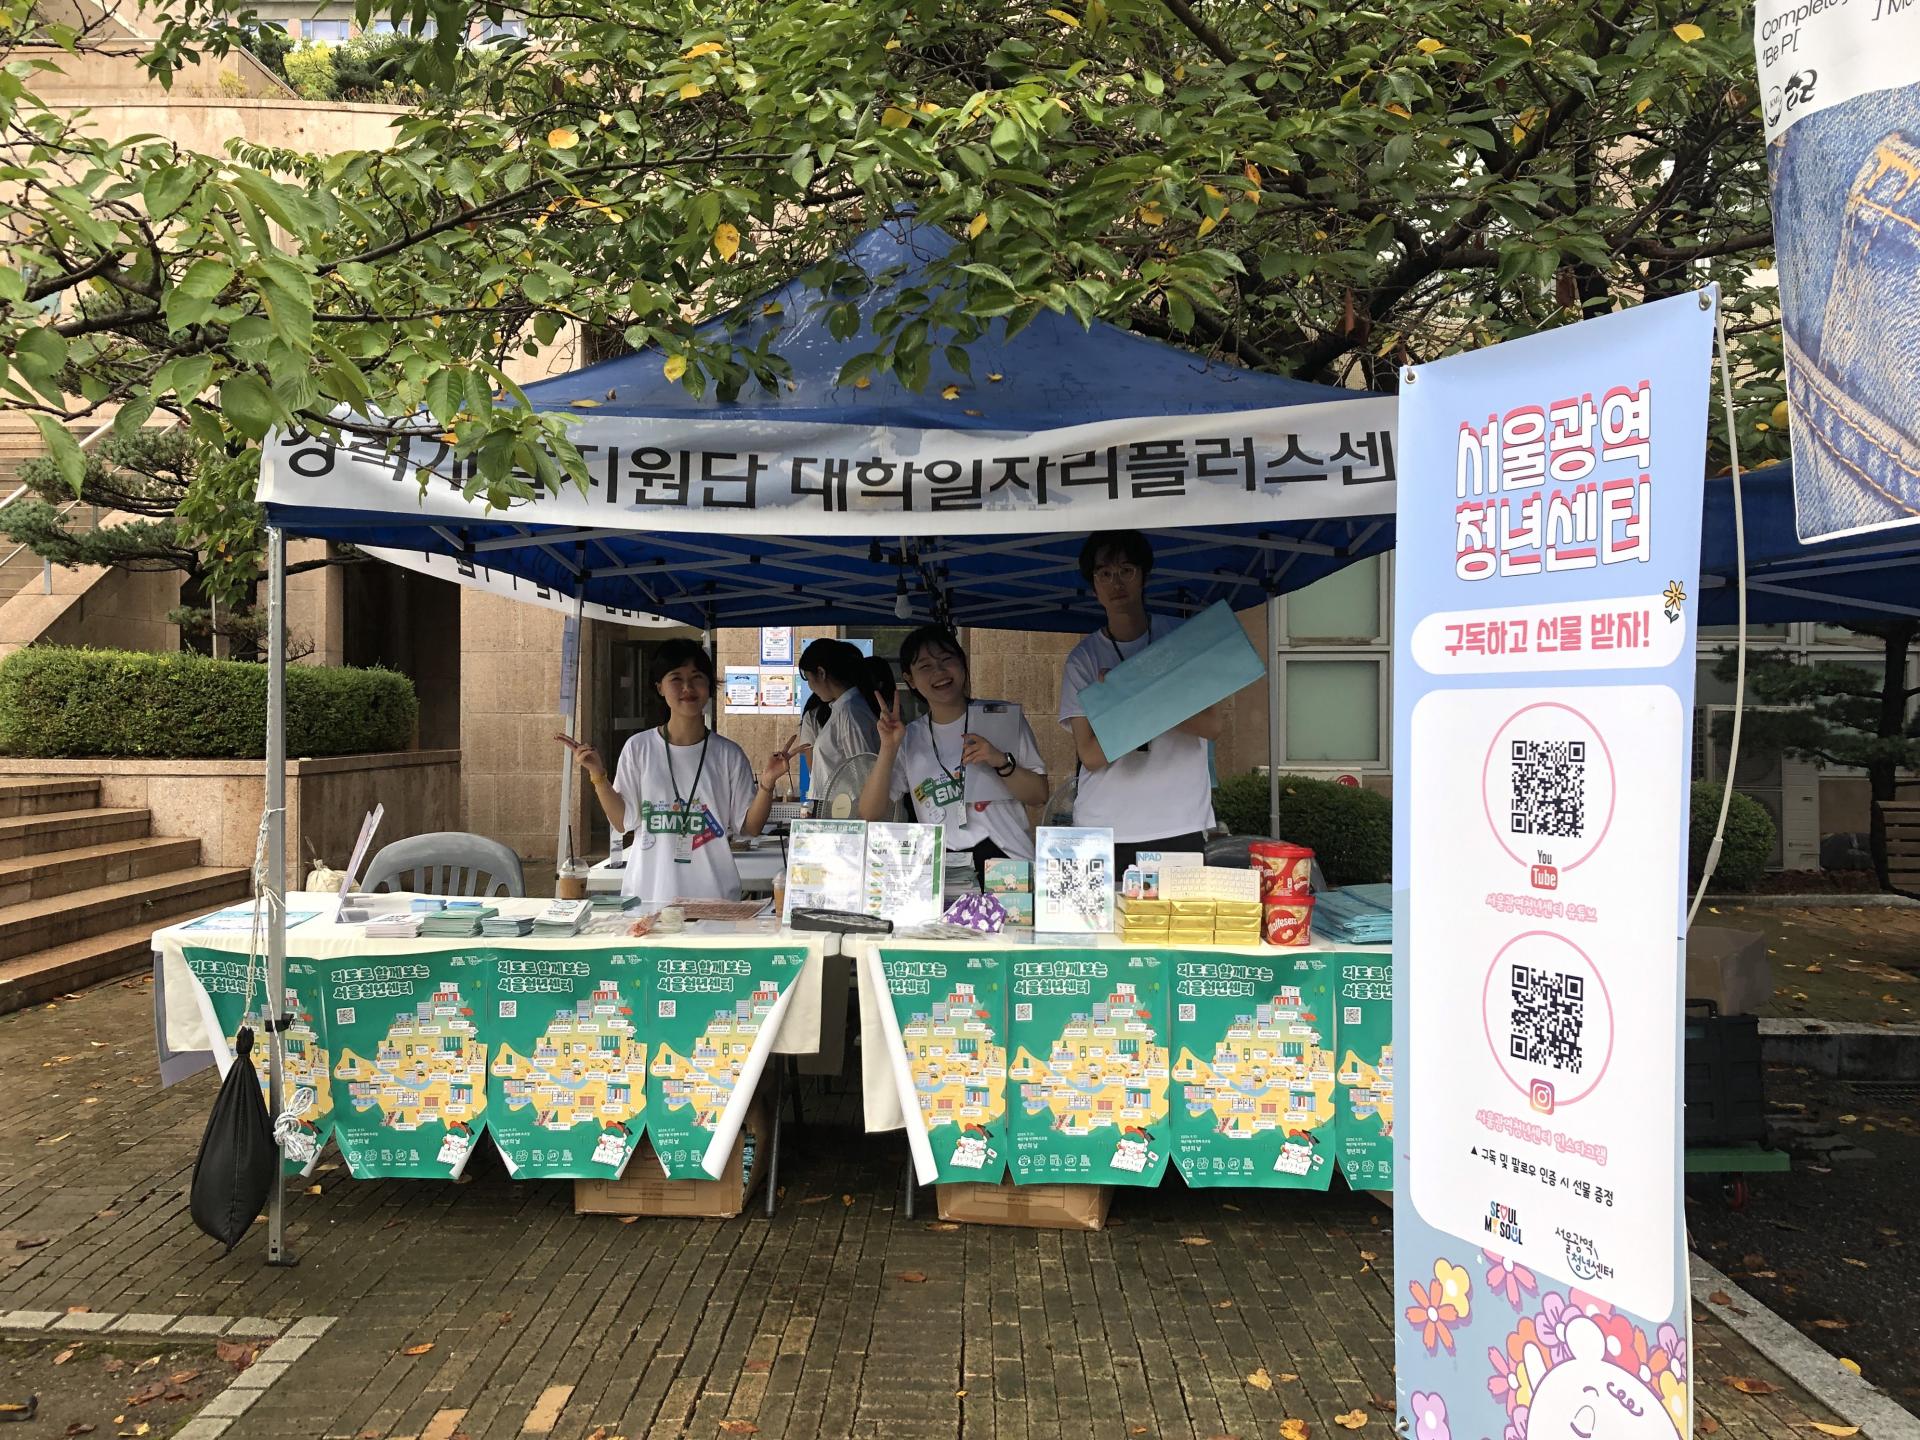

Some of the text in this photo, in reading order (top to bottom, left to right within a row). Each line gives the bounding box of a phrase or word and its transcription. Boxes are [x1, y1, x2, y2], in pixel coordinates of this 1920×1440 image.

[1456, 380, 1651, 498] 서울광역
[791, 430, 1397, 512] 대학일자리플러스센
[1456, 474, 1651, 582] 청년센터
[1444, 611, 1650, 656] 구독하고 선물 받자!
[1537, 849, 1553, 865] You
[1532, 866, 1557, 887] Tube
[1485, 892, 1598, 923] 서울광역청년센터 유튜브
[331, 967, 374, 983] 지도로
[498, 960, 537, 976] 지도로
[657, 959, 698, 975] 지도로
[1014, 962, 1054, 977] 지도로
[1177, 963, 1218, 978] 지도로
[1343, 966, 1384, 982] 지도로
[333, 981, 414, 1000] 서울청년센터
[498, 977, 573, 993] 서울청년센터
[657, 976, 733, 992] 서울청년센터
[1014, 979, 1090, 995] 서울청년센터
[1177, 979, 1255, 996] 서울청년센터
[1476, 1109, 1608, 1167] 서울광역청년센터 인스타그램
[1482, 1148, 1613, 1207] 구독 및 팔로우 인증 시 선물 증정
[1555, 1227, 1593, 1255] 서울광역
[1571, 1253, 1614, 1280] 청년센터
